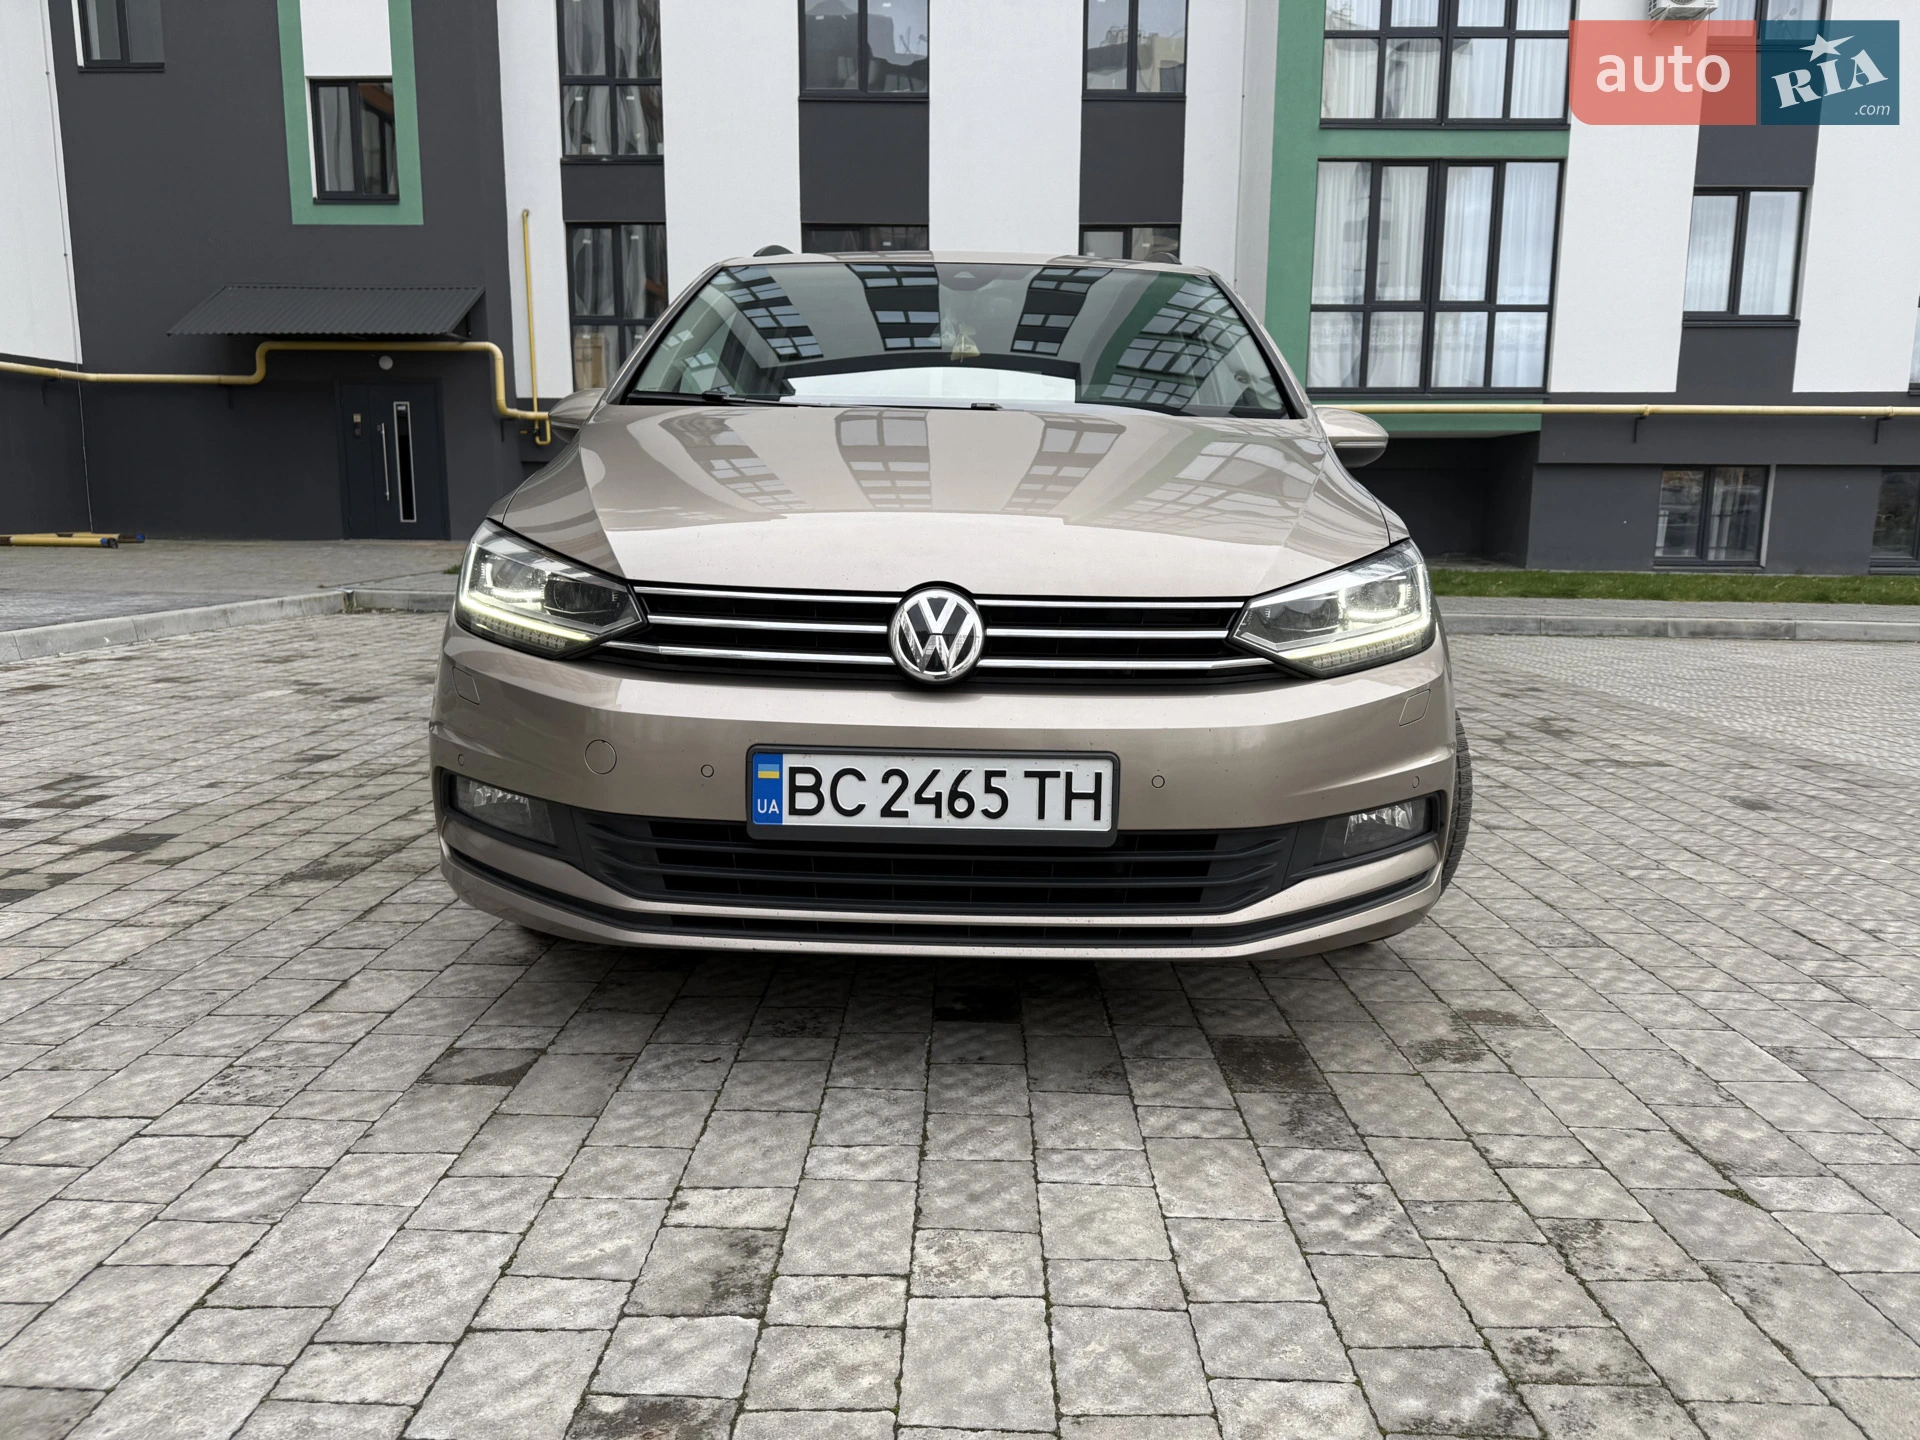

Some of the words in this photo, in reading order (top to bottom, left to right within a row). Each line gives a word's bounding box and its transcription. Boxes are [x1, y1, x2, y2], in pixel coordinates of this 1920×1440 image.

[894, 591, 979, 677] VW
[757, 799, 780, 815] UA
[788, 765, 867, 817] BC
[880, 768, 1009, 819] 2465
[1024, 770, 1102, 821] TH
